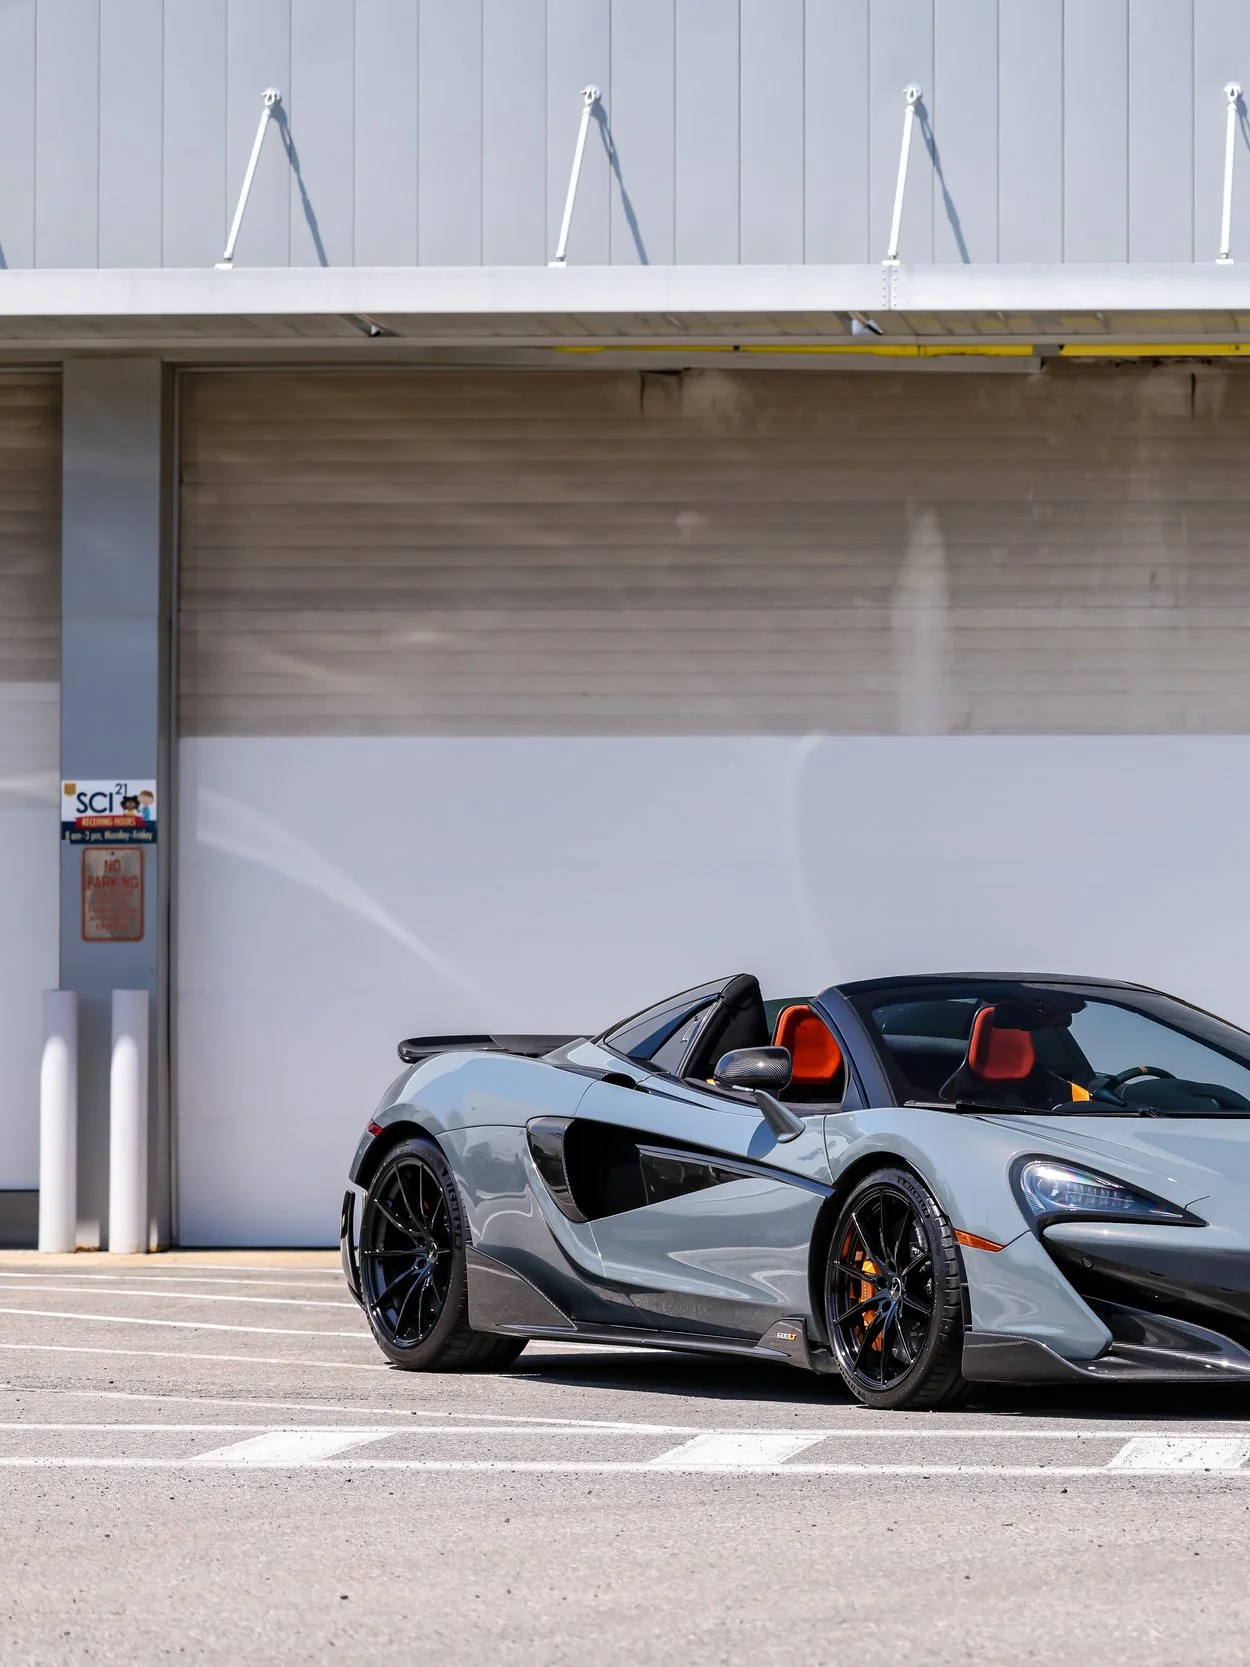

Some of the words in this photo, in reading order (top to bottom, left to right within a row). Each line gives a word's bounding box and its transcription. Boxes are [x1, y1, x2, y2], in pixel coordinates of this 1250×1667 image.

[76, 792, 114, 814] SCI
[81, 817, 113, 827] RECEIVING
[114, 817, 137, 827] HOURS
[104, 858, 122, 873] NO
[87, 874, 139, 889] PARKING
